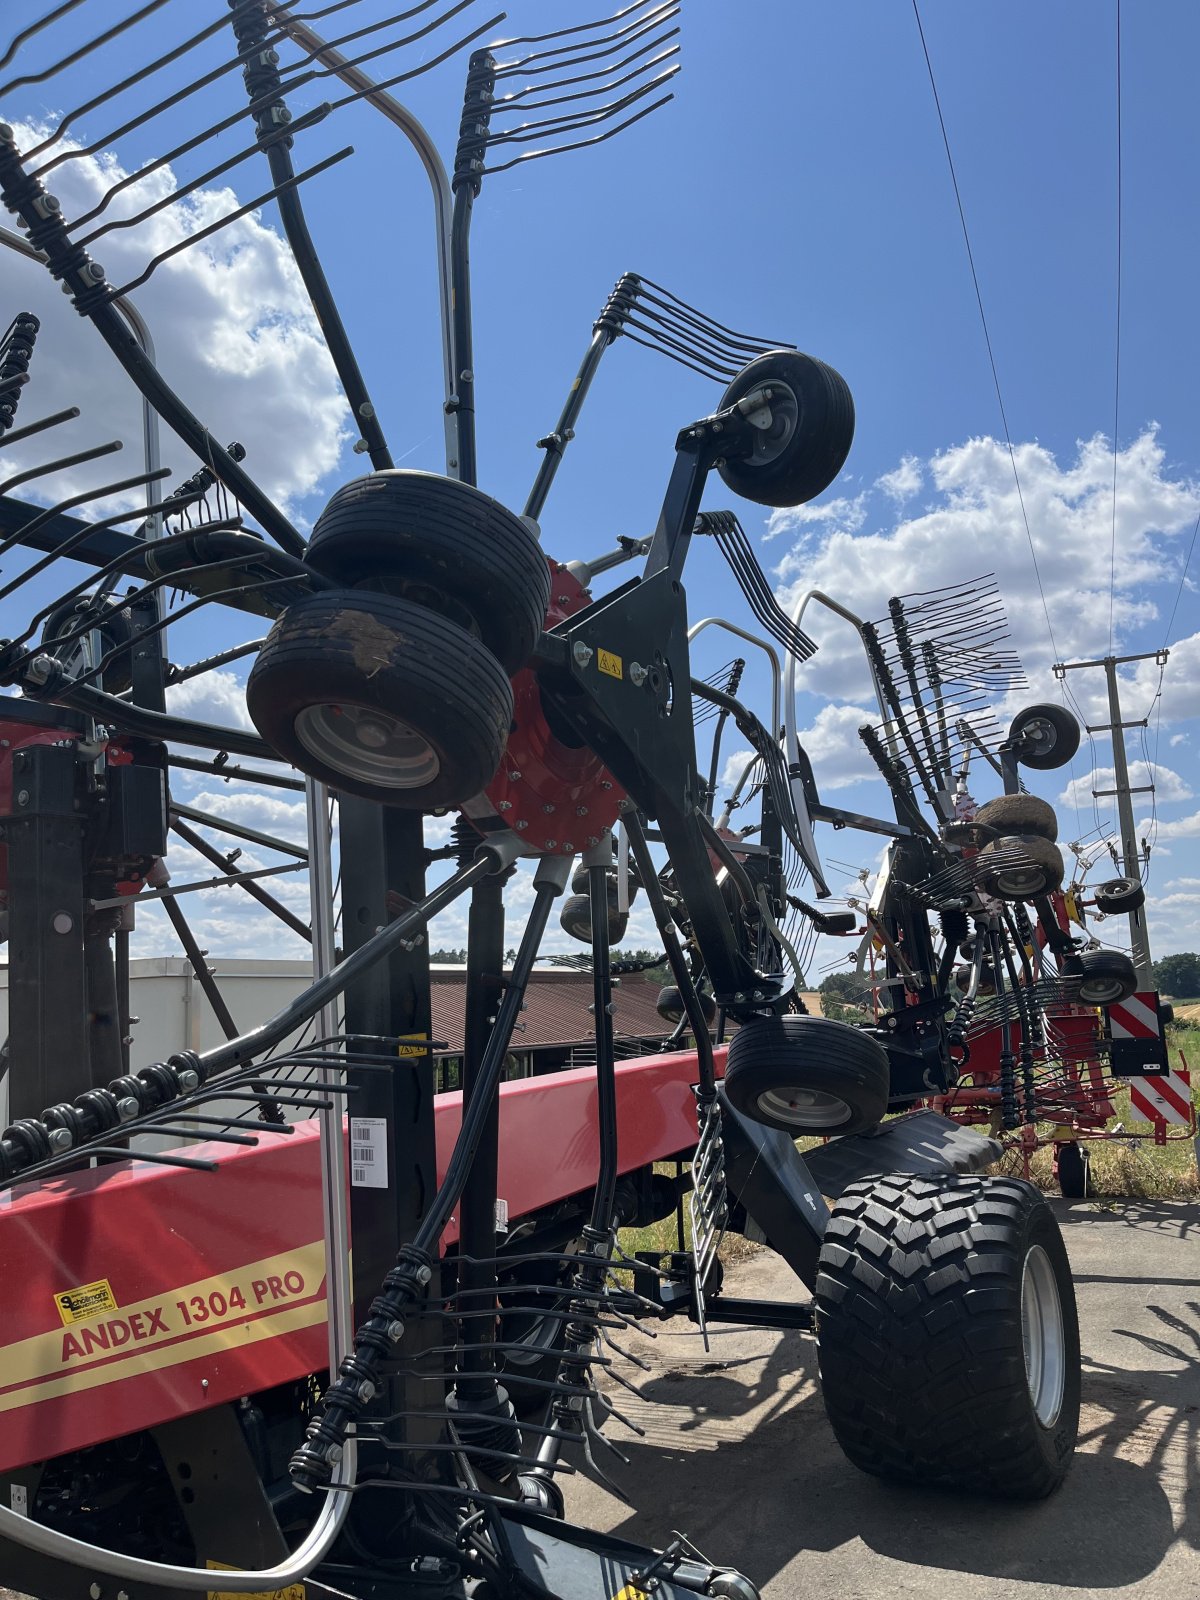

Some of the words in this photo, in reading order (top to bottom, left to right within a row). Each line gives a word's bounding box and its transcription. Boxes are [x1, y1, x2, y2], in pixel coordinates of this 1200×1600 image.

[62, 1307, 170, 1362] ANDEX
[176, 1286, 247, 1325] 1304
[251, 1270, 305, 1304] PRO
